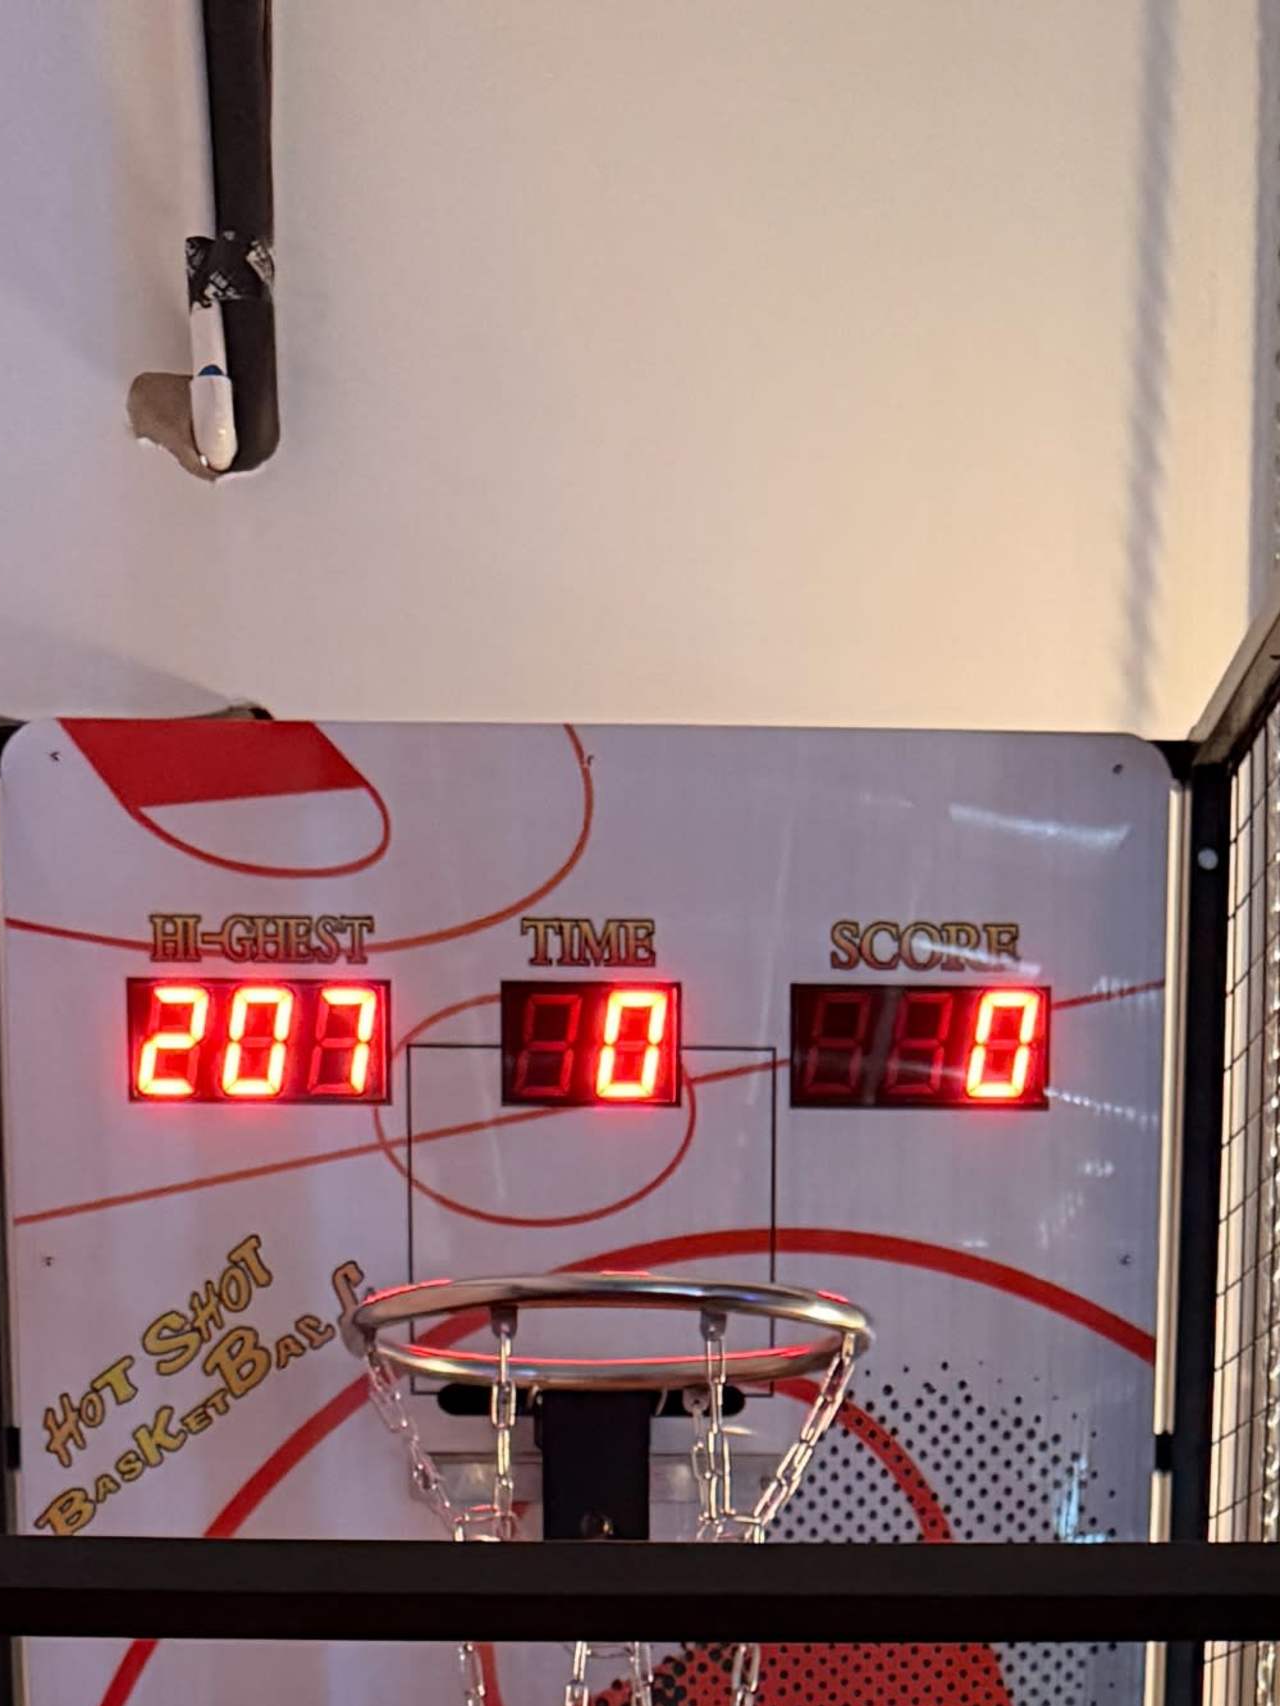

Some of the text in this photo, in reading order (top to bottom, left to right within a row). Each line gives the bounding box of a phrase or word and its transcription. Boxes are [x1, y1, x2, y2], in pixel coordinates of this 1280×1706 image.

[149, 913, 375, 965] HI-GHEST
[522, 916, 656, 967] TIME
[829, 919, 1021, 971] SCORE
[137, 985, 377, 1097] 207
[595, 989, 669, 1099] 0
[965, 991, 1041, 1099] 0
[43, 1234, 273, 1468] HOT SHOT
